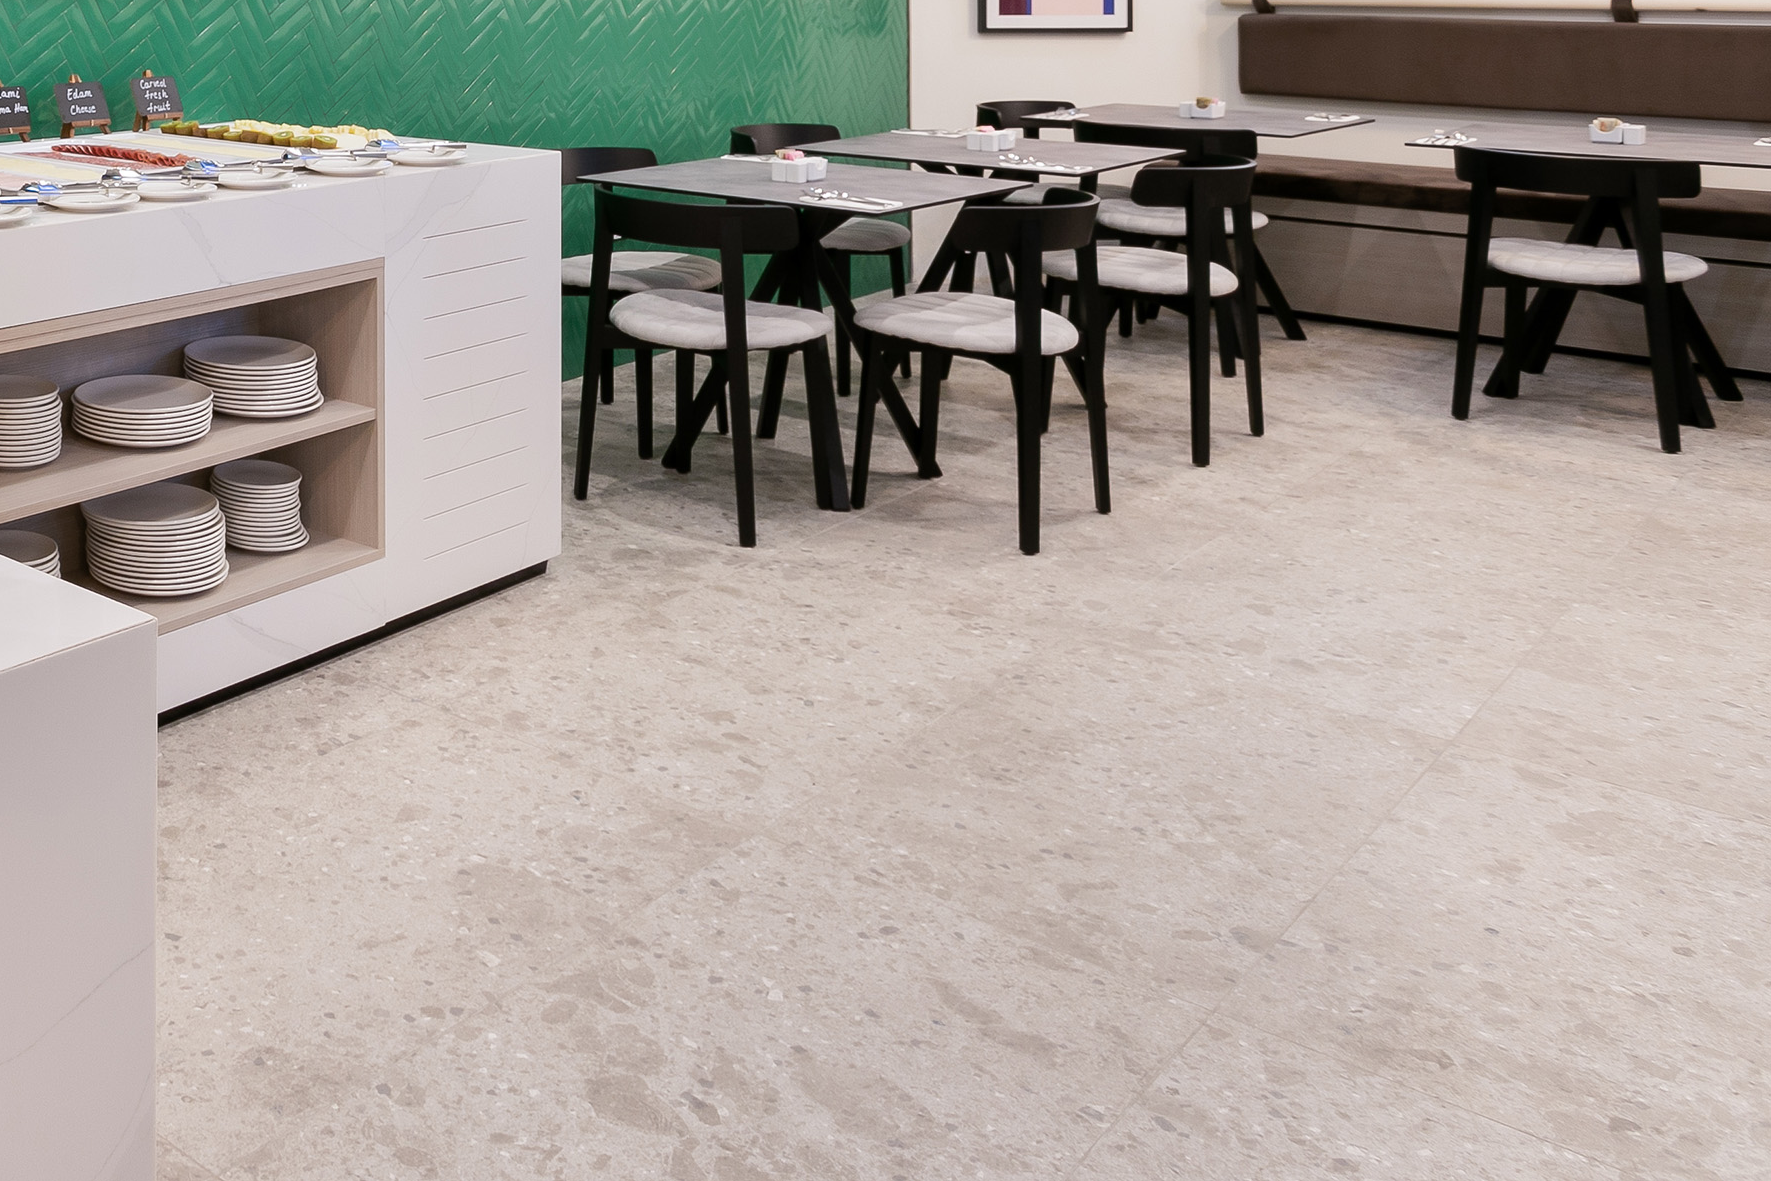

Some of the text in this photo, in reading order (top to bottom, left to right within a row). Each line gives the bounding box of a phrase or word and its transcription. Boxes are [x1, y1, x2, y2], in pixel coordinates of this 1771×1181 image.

[139, 78, 167, 90] Carved
[66, 88, 93, 101] Edam
[144, 89, 169, 100] fresh
[69, 104, 97, 116] Cheese
[146, 100, 171, 113] fruit
